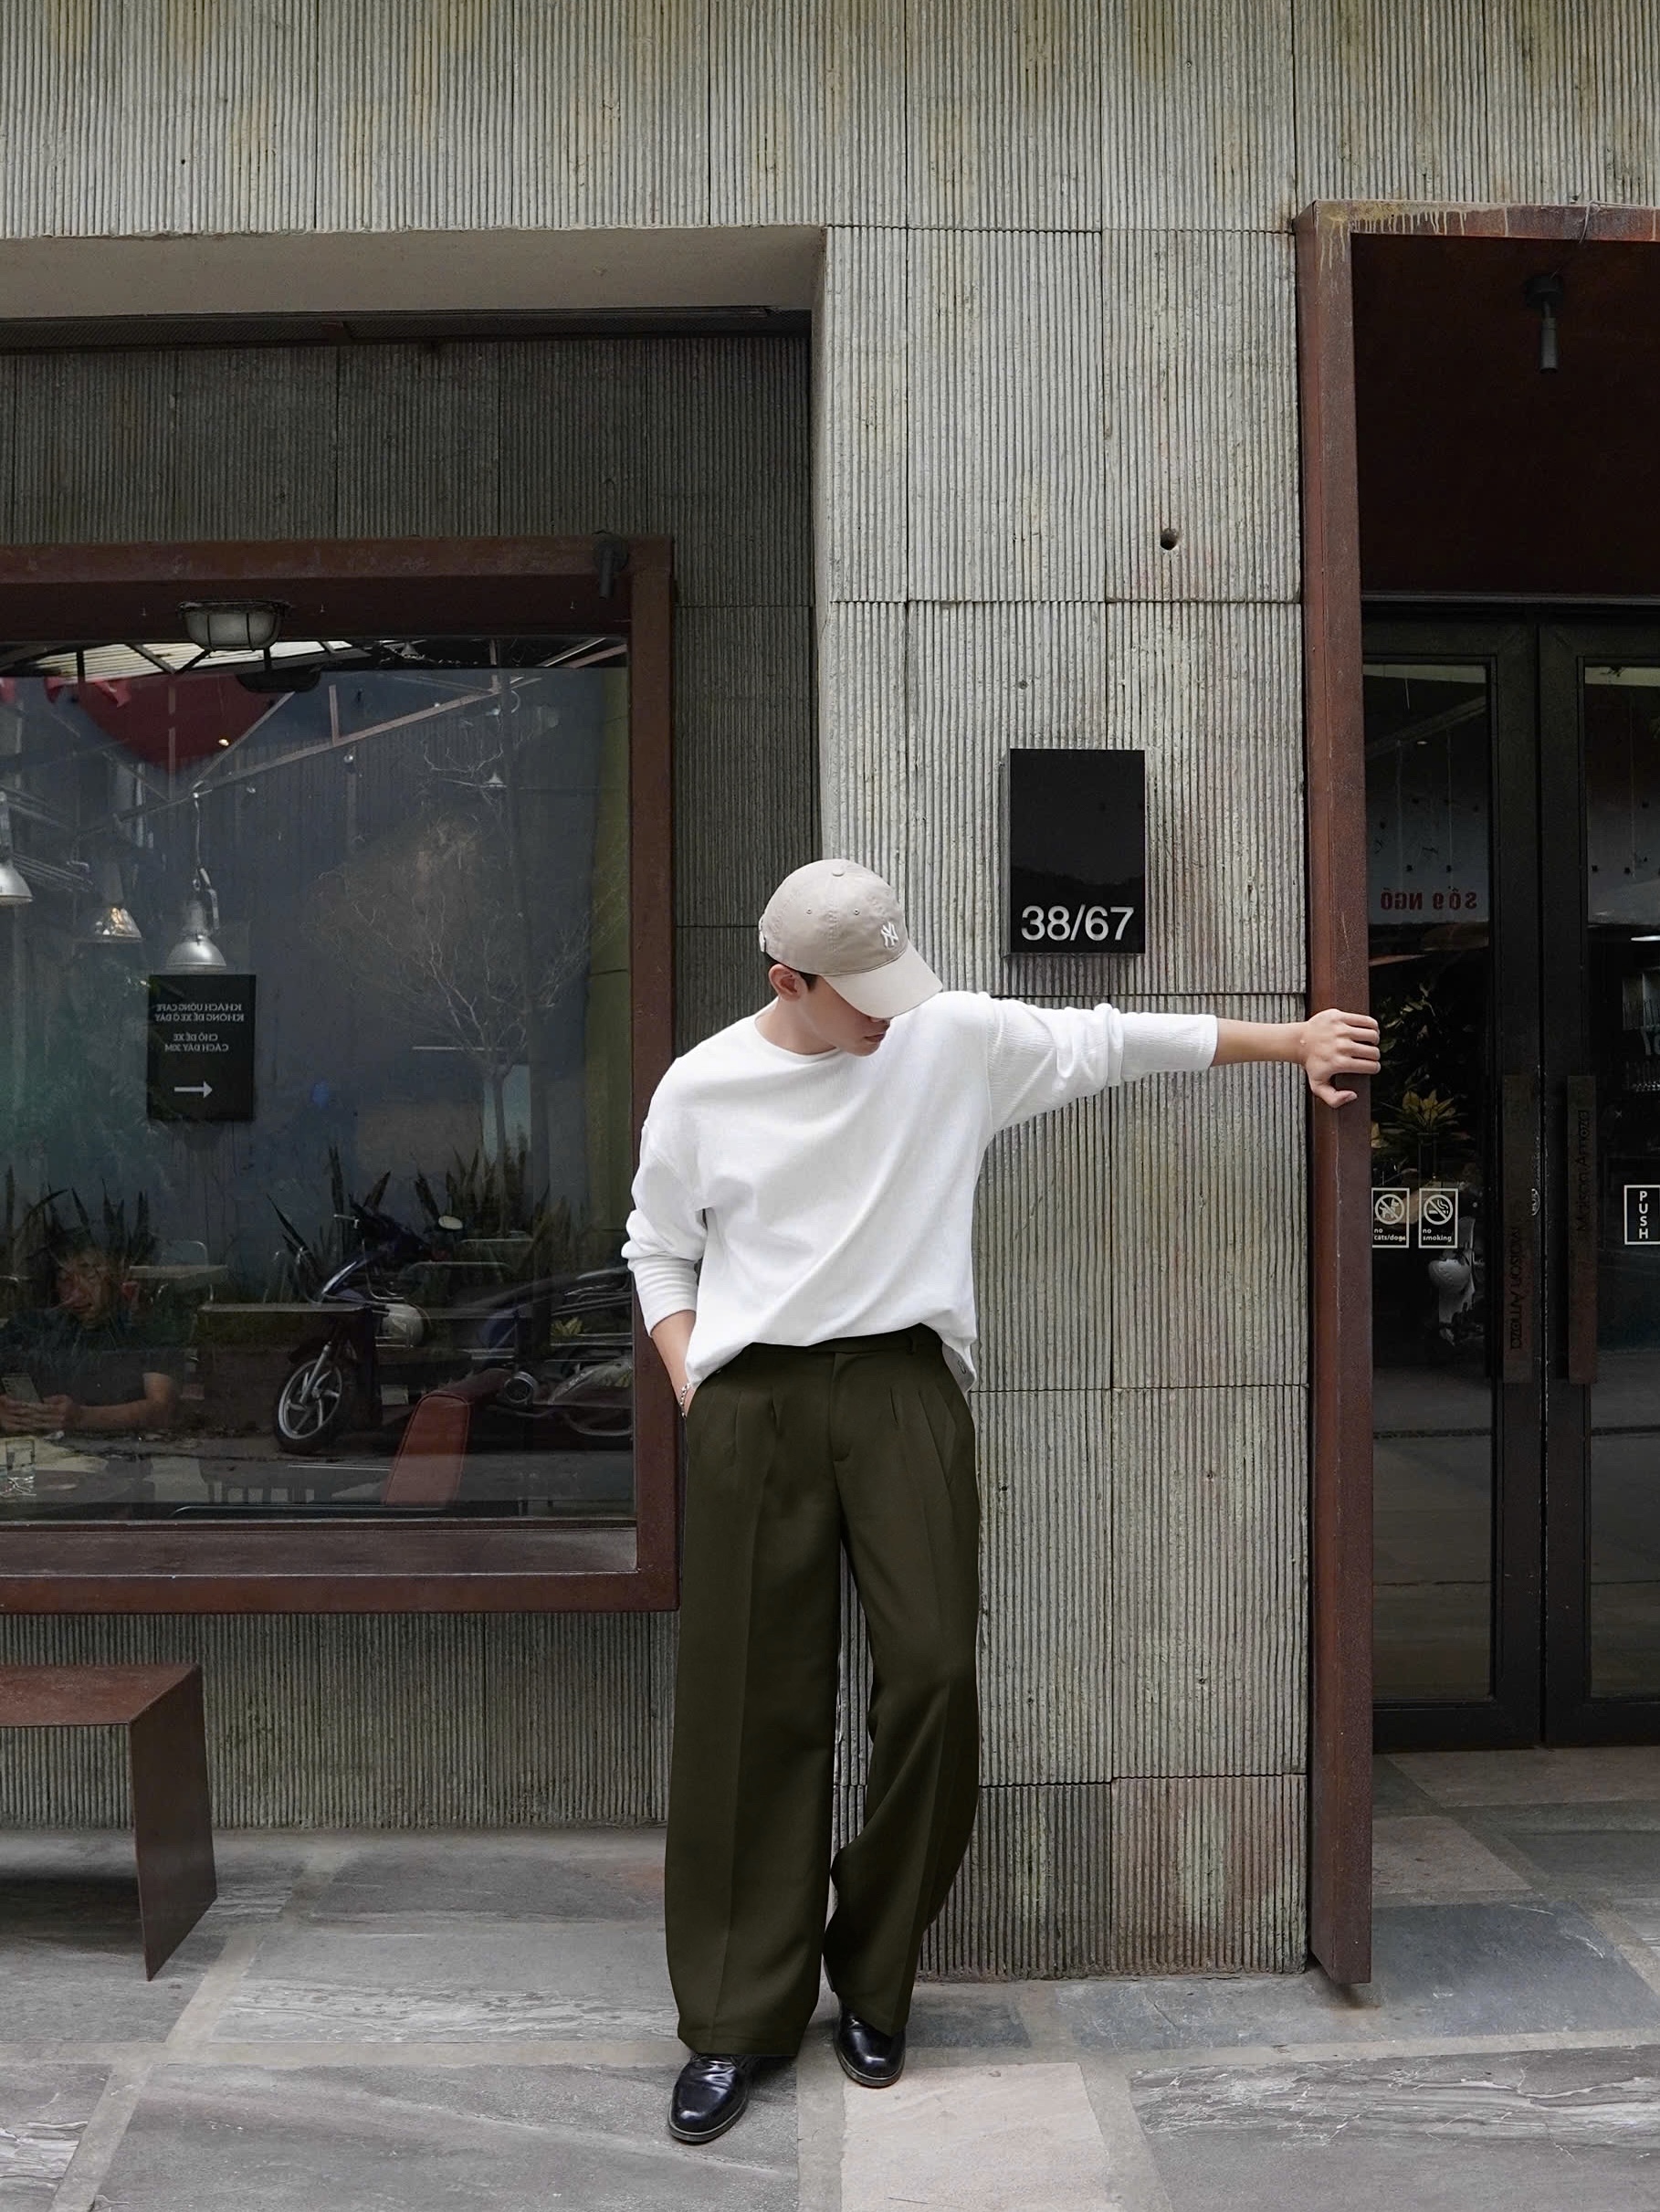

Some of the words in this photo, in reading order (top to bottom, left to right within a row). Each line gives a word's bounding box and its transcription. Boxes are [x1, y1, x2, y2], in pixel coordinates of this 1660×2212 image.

[880, 921, 898, 948] NY
[1021, 904, 1134, 942] 38/67
[1638, 1190, 1649, 1239] PUSH
[1422, 1235, 1452, 1243] smoking
